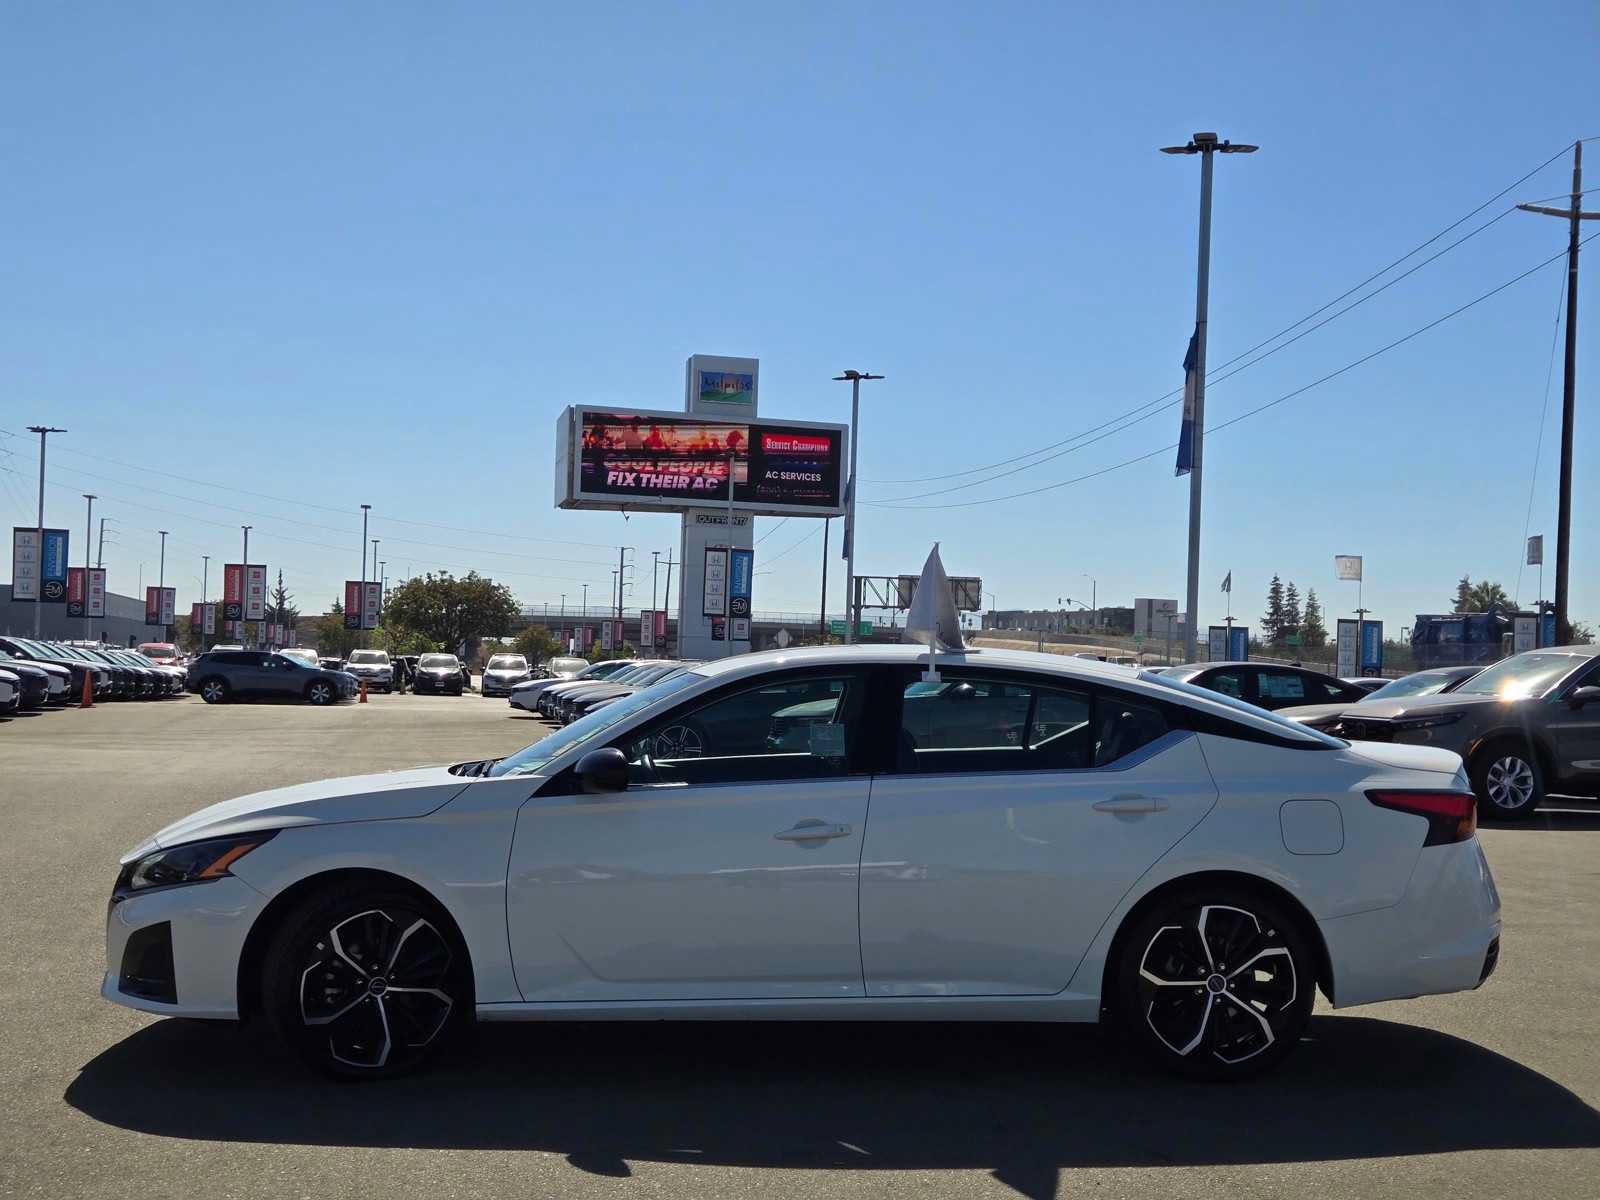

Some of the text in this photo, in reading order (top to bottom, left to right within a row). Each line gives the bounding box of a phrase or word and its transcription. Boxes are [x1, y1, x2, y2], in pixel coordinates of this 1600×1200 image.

[606, 471, 718, 489] FIX THEIR AC
[765, 470, 822, 482] AC SERVICES
